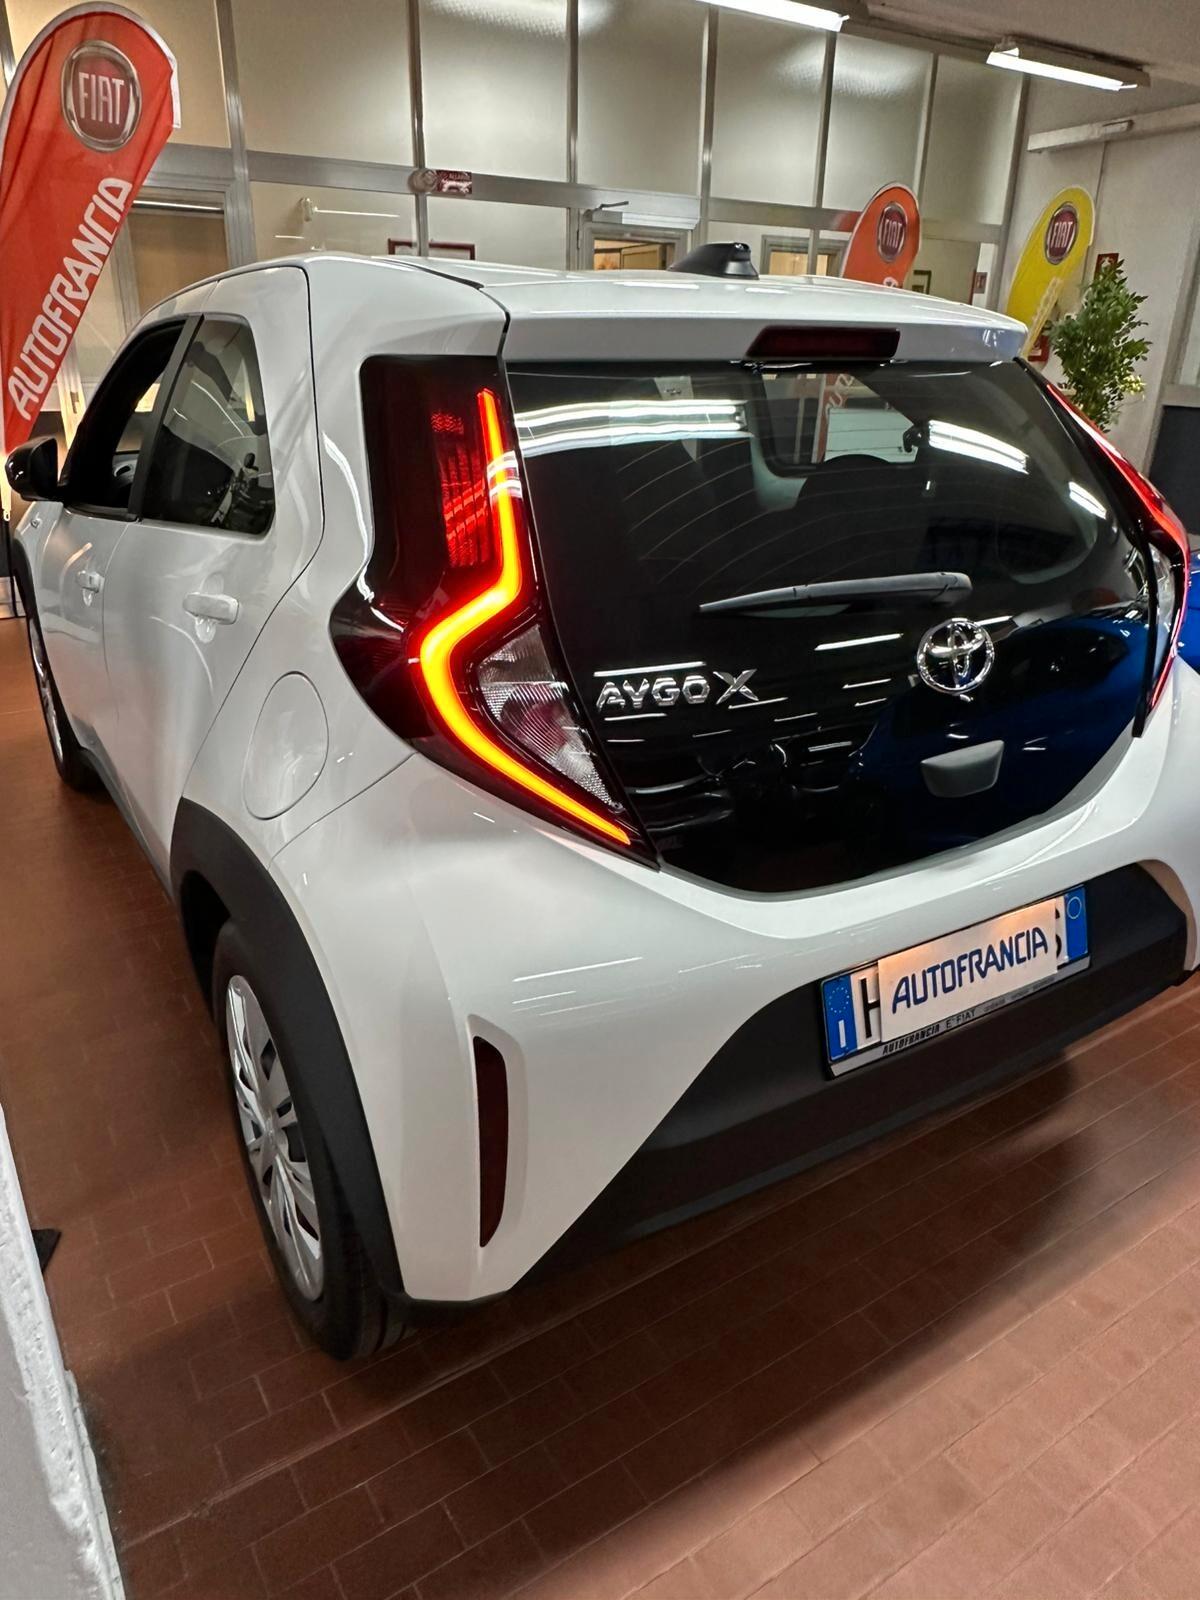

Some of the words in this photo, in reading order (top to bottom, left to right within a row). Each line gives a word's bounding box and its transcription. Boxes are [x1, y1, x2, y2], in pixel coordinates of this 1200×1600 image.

[78, 71, 125, 125] FIAT
[882, 219, 903, 248] FIAT
[1050, 221, 1073, 249] FIAT
[7, 177, 133, 421] AUTOFRANCIA
[595, 675, 711, 709] AYGO
[712, 668, 759, 705] X
[891, 927, 1048, 1014] AUTOFRANCIA
[882, 1023, 940, 1056] AUTOFRANCIA
